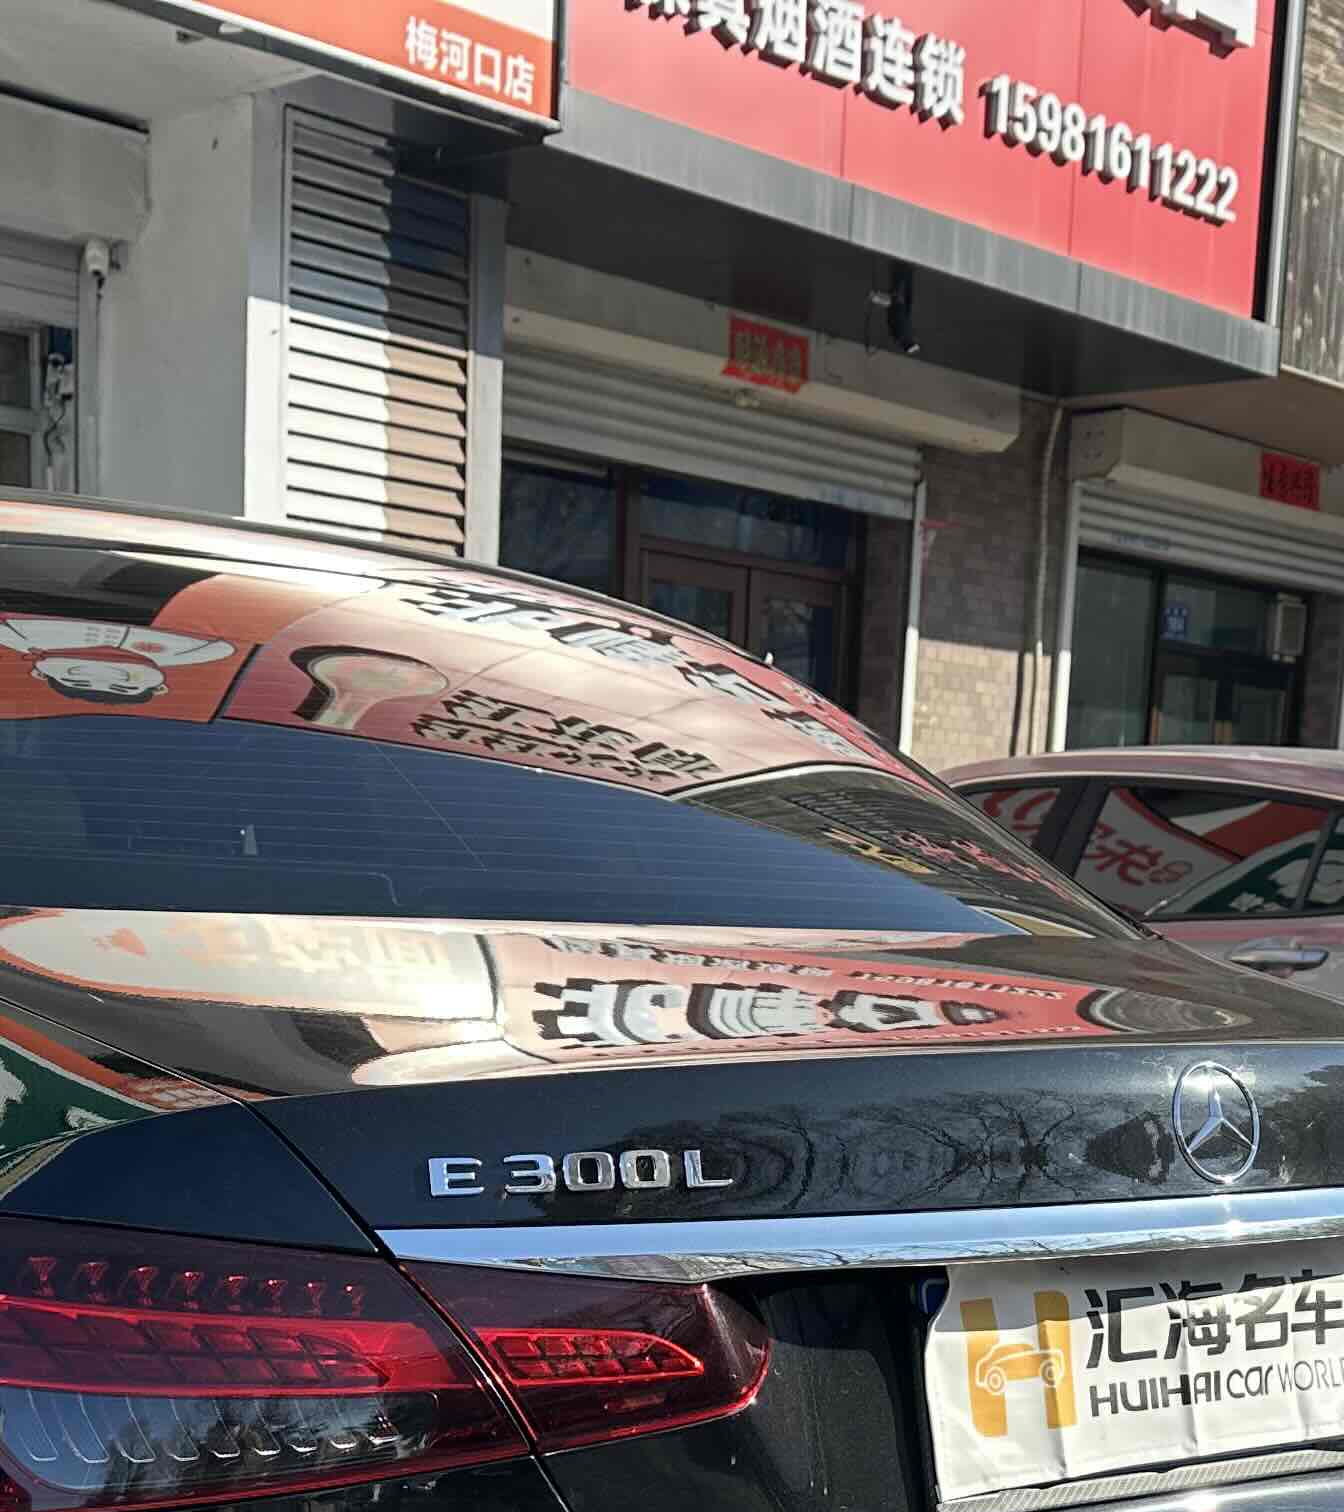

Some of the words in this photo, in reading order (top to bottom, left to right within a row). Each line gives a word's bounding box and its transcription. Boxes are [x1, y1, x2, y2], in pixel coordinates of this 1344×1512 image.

[403, 16, 536, 104] 梅河口店
[988, 74, 1239, 222] 15981611222
